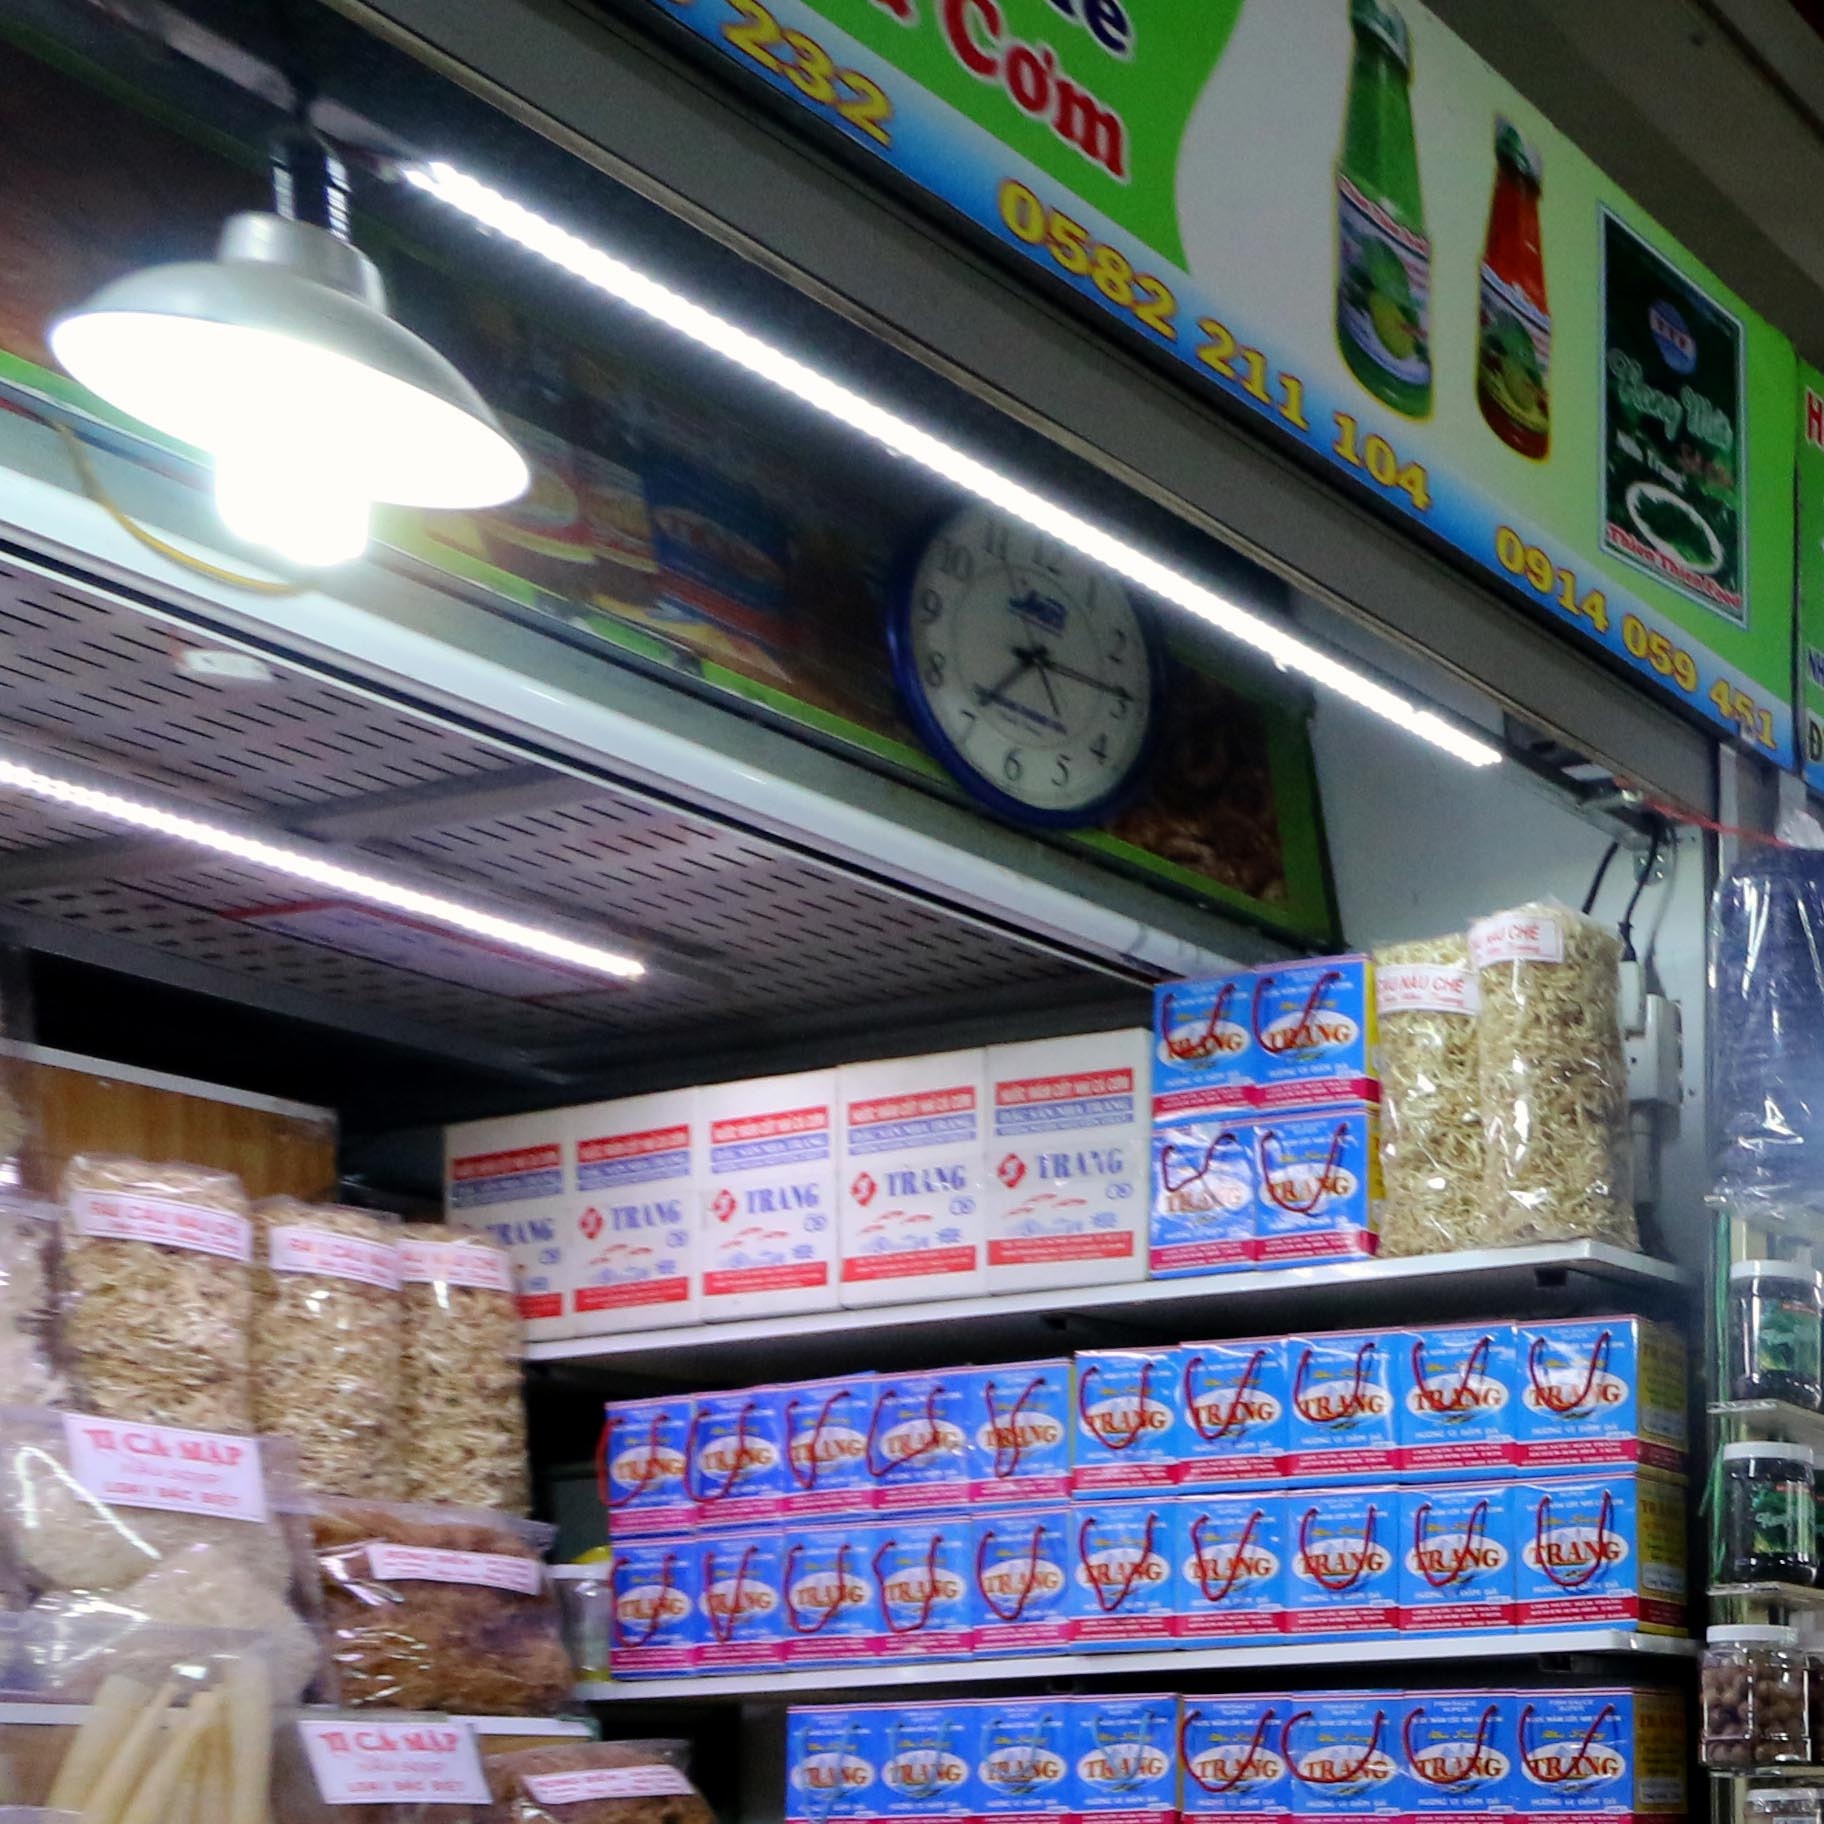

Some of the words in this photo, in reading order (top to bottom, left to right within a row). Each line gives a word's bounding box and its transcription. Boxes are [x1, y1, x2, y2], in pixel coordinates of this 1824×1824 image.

[724, 0, 892, 147] 232
[999, 178, 1177, 340] 0582
[1196, 318, 1310, 431] 211
[1333, 411, 1431, 511] 104
[1496, 525, 1608, 633] 0914
[1621, 613, 1698, 694] 059
[1709, 678, 1777, 750] 451
[1035, 1147, 1125, 1181] TRANG
[885, 1164, 967, 1198] TRANG
[745, 1182, 820, 1215] TRANG
[1298, 1393, 1386, 1420] TRANG
[1297, 1548, 1385, 1576] TRANG
[1411, 1544, 1501, 1572] TRANG
[1527, 1537, 1623, 1566] TRANG
[1528, 1756, 1620, 1778] TRANG
